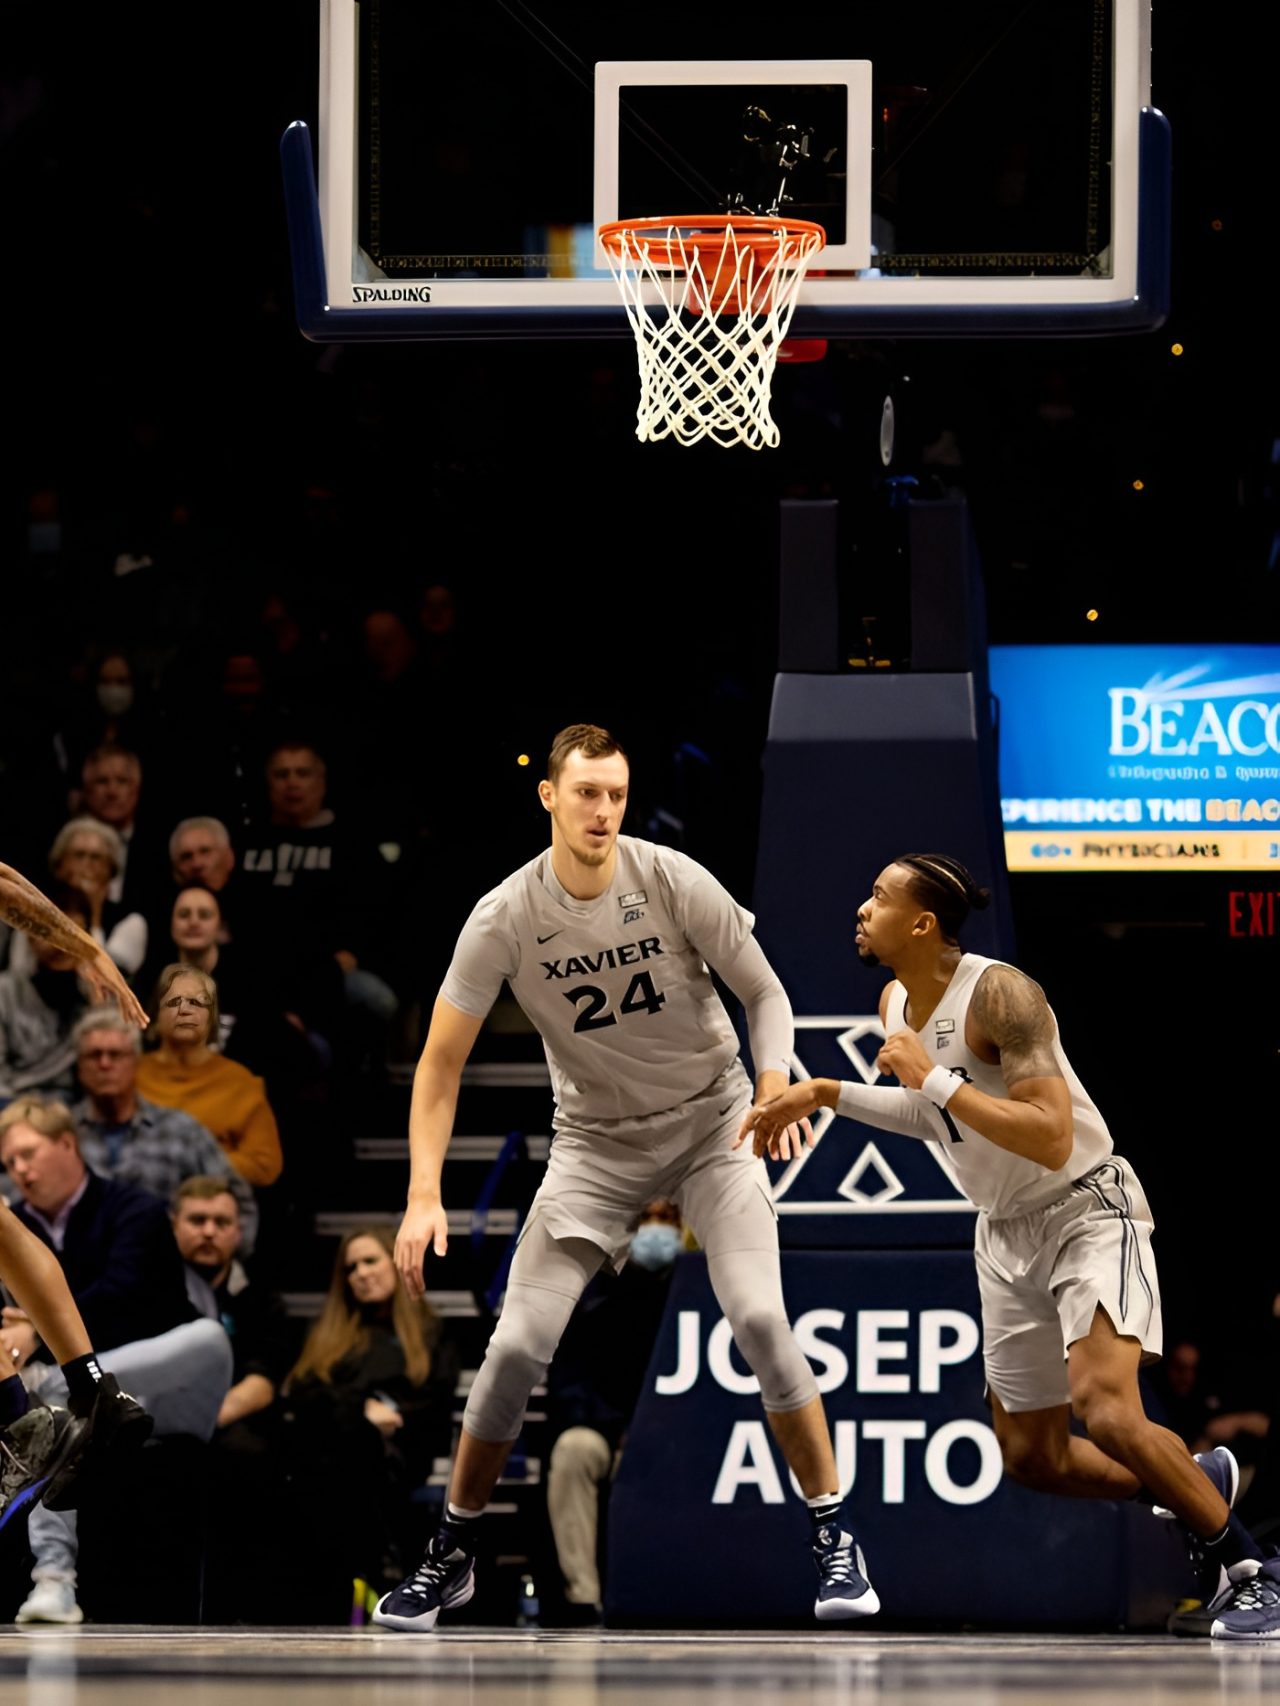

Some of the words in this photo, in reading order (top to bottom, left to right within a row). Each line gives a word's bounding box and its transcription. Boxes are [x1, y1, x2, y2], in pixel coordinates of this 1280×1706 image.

[352, 286, 432, 303] SPALDING
[1147, 798, 1202, 823] THE
[1229, 890, 1280, 937] EXI
[539, 936, 665, 980] XAVIER
[562, 970, 666, 1034] 24
[654, 1309, 980, 1395] JOSEP
